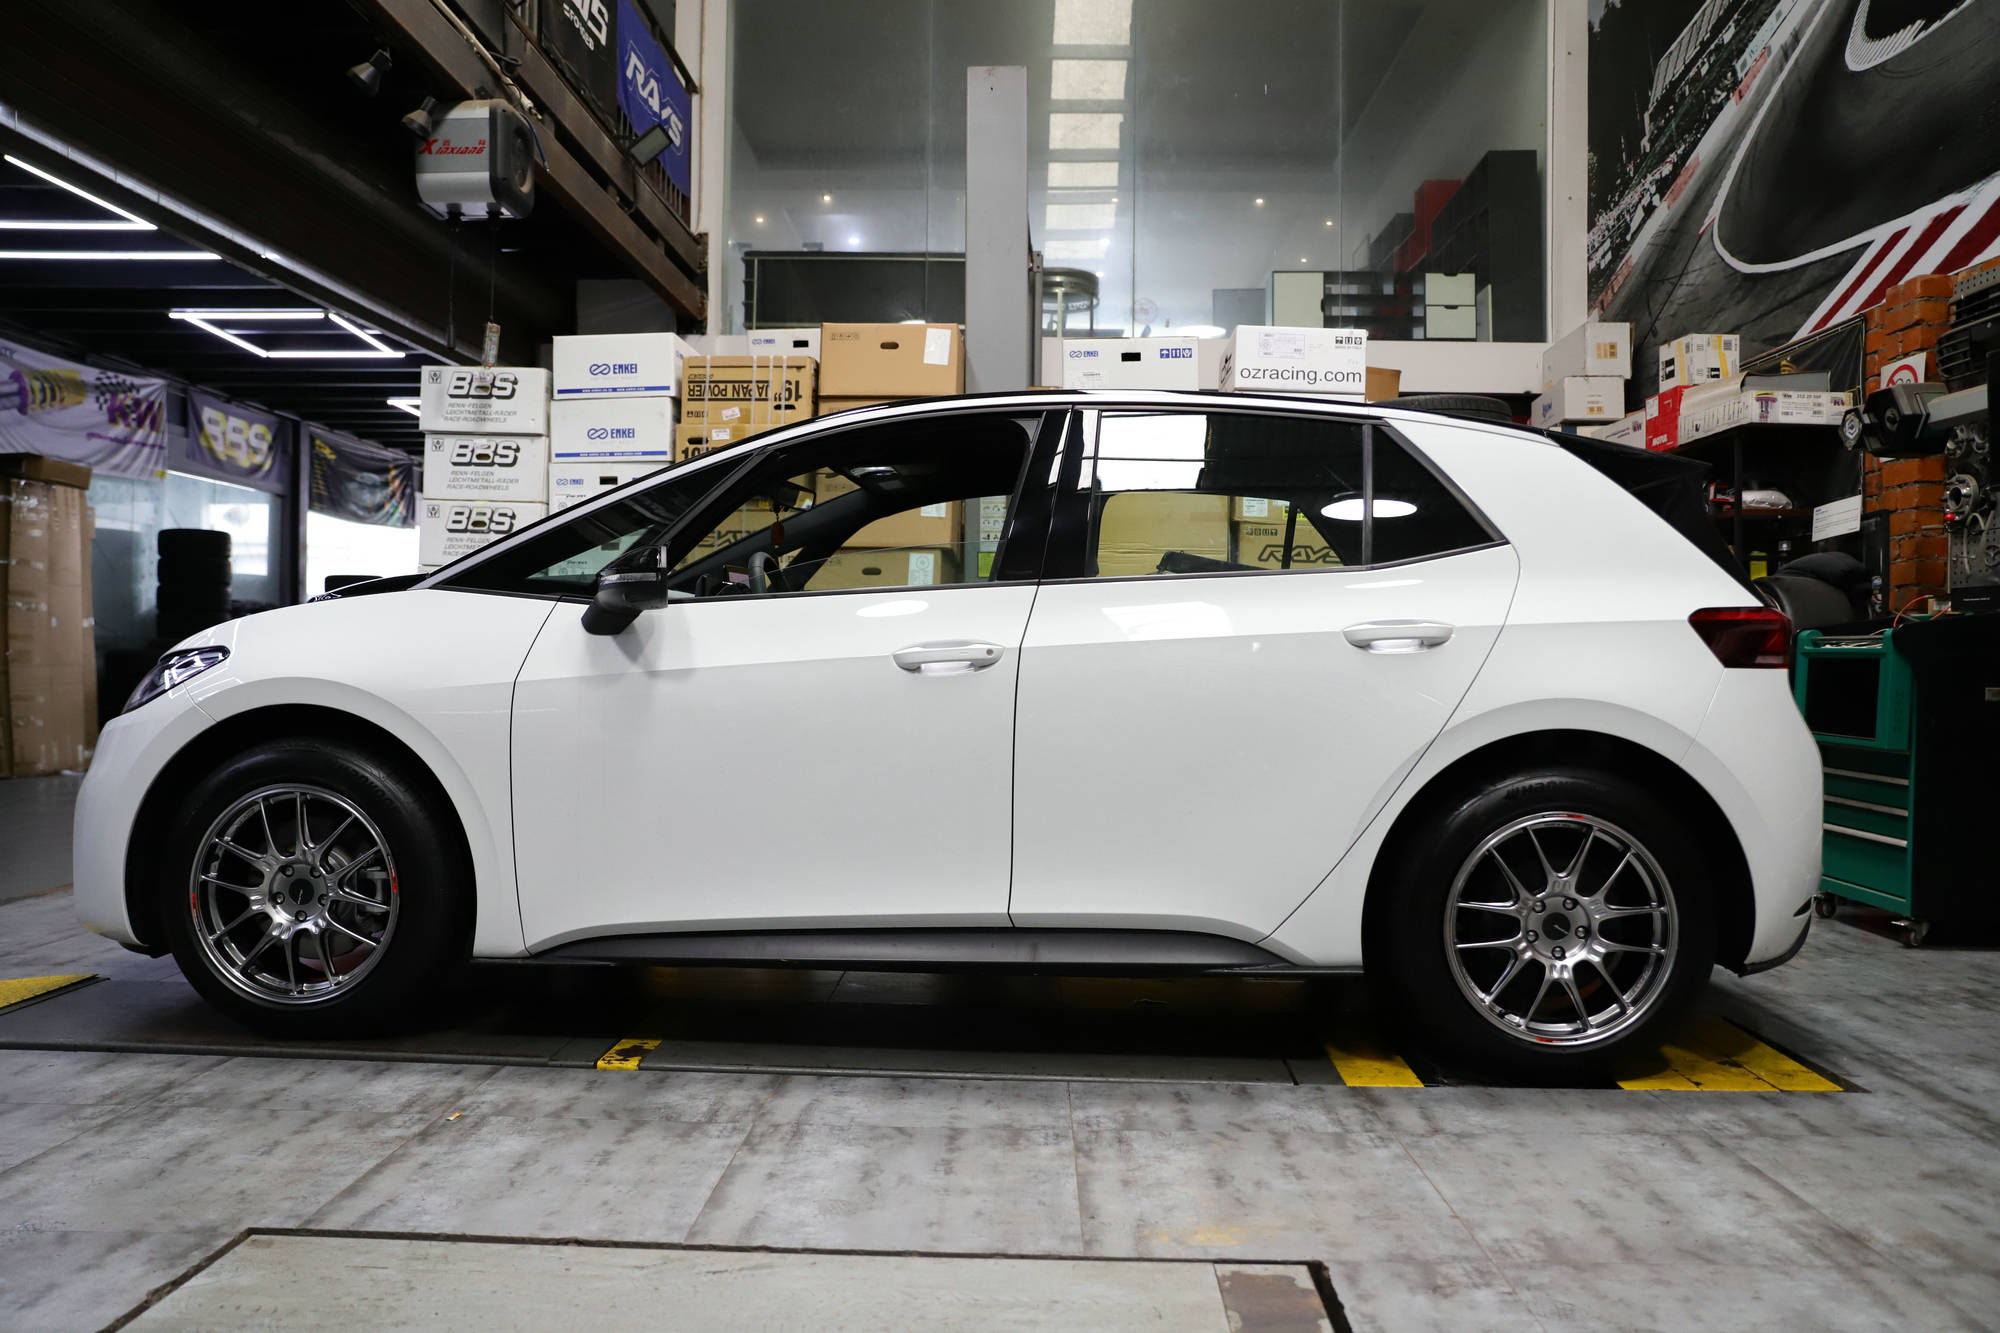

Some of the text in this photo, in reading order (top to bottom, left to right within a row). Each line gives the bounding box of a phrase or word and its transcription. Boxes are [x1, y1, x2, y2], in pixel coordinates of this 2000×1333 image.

[612, 363, 638, 375] ENKEI
[1240, 366, 1362, 385] ozracing.com
[447, 371, 519, 399] BBS
[108, 391, 165, 434] KW
[201, 406, 273, 471] BBS
[610, 428, 635, 439] ENKEI
[450, 439, 520, 467] BBS
[446, 505, 516, 534] BBS
